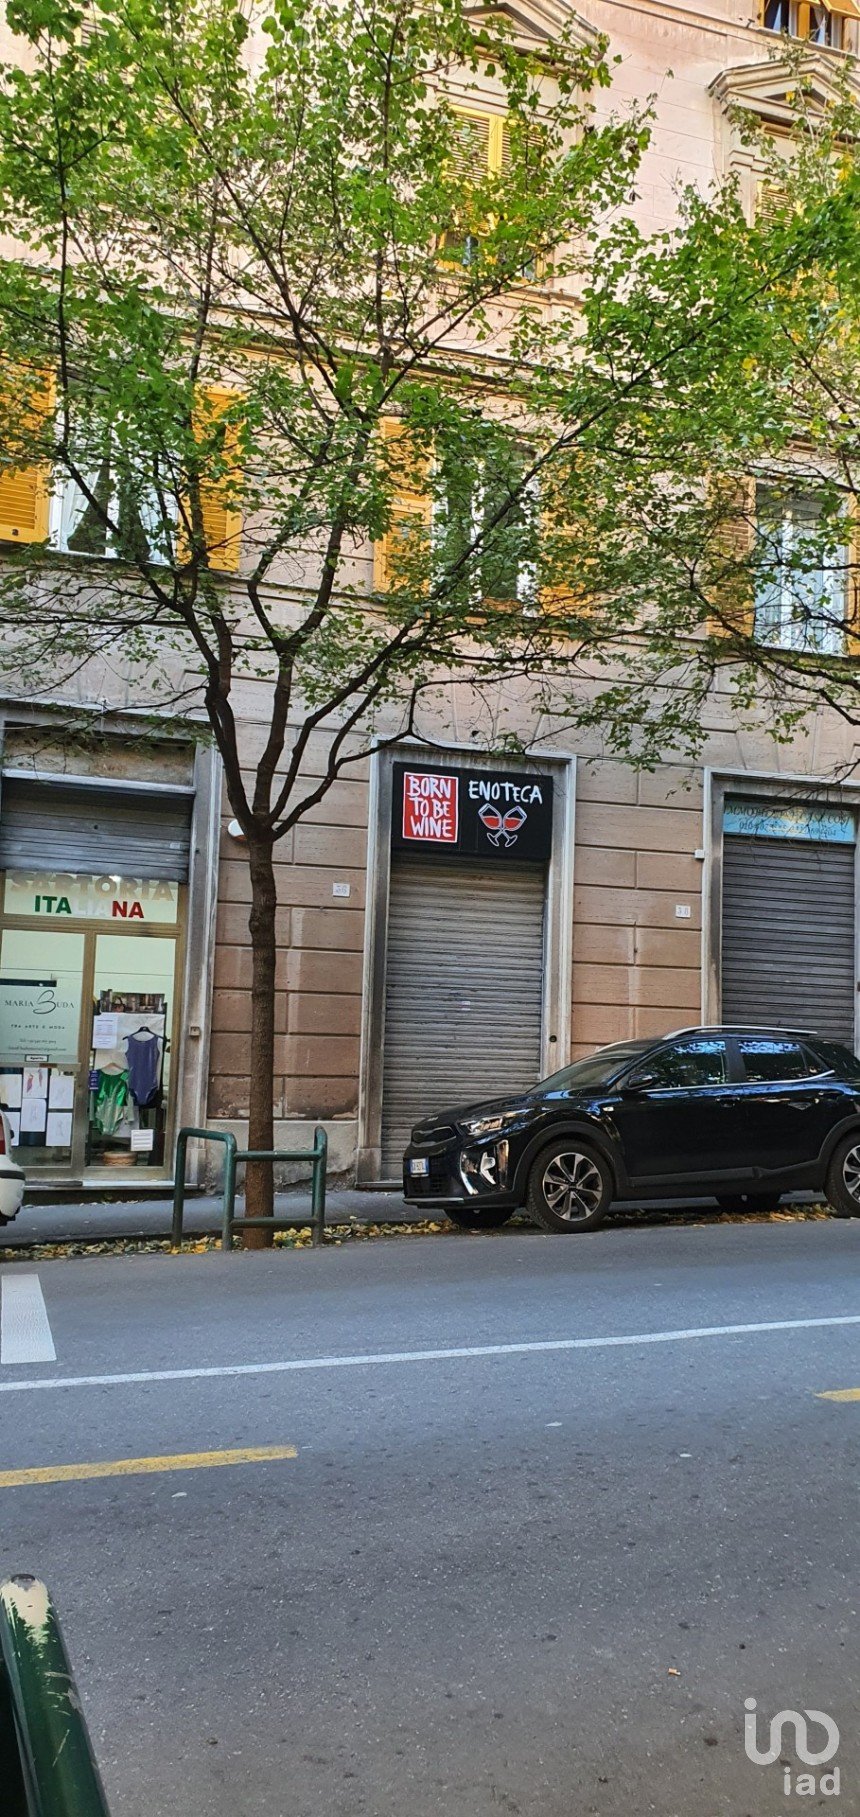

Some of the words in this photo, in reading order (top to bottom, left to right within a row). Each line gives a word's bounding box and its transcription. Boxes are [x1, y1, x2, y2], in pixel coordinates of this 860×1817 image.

[407, 775, 452, 799] BORN
[468, 780, 543, 805] ENOTECA
[409, 796, 429, 817] TO
[432, 799, 451, 819] BE
[410, 815, 453, 838] WINE
[10, 873, 173, 901] SARTORIA
[34, 894, 145, 919] ITALIANA
